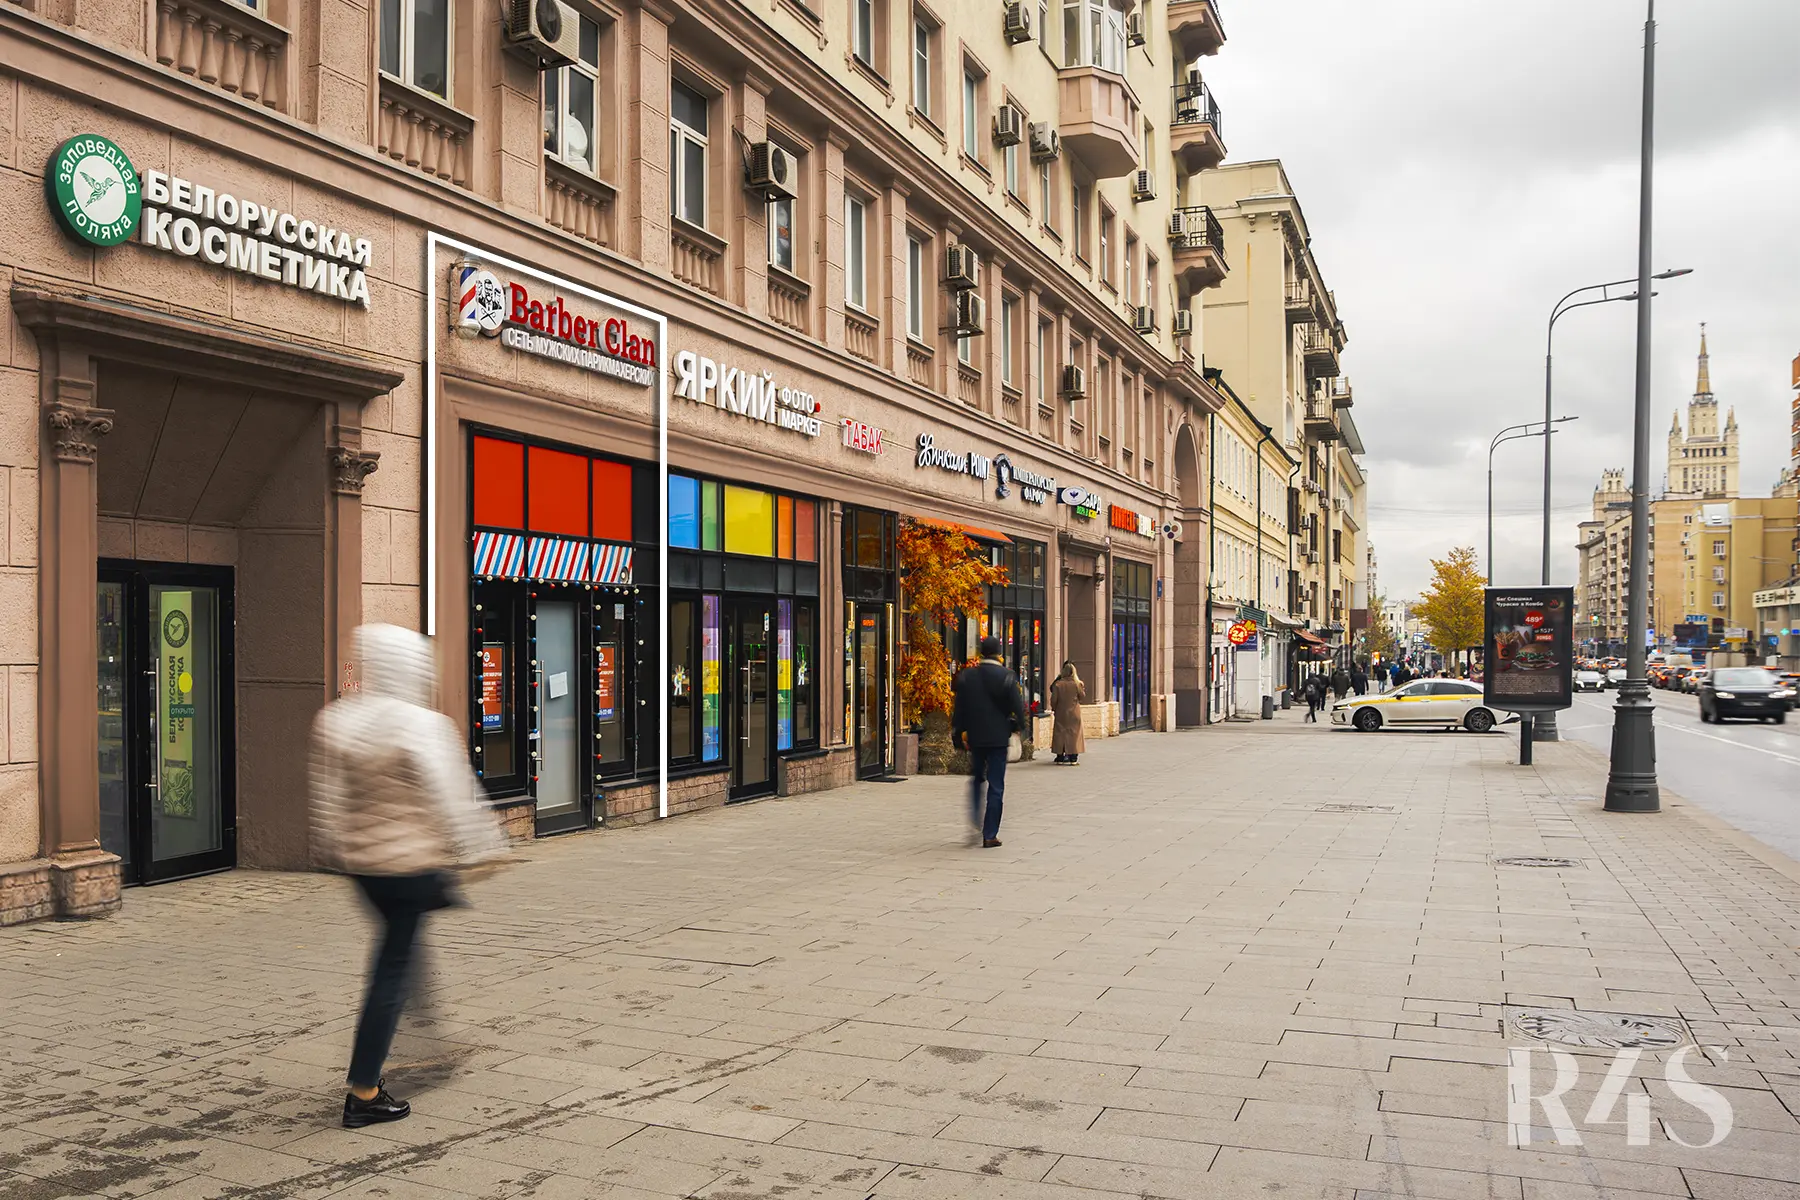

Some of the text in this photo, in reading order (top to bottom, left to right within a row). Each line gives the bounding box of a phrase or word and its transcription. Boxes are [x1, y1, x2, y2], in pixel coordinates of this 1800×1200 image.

[142, 169, 372, 267] БЕЛОРУССКАЯ
[141, 206, 371, 310] КОСМЕТИКА
[505, 281, 656, 367] Barber Clan
[503, 327, 656, 388] СЕТЬ МУЖСКИХ ПАРИКМАХЕРСКИХ
[674, 349, 777, 424] ЯРКИЙ
[780, 386, 815, 415] ФОТО
[779, 408, 823, 438] МАРКЕТ
[842, 417, 884, 456] ТАБАК
[969, 451, 991, 480] POINT
[1232, 630, 1244, 638] 24
[171, 707, 195, 715] ОТКРЫТО
